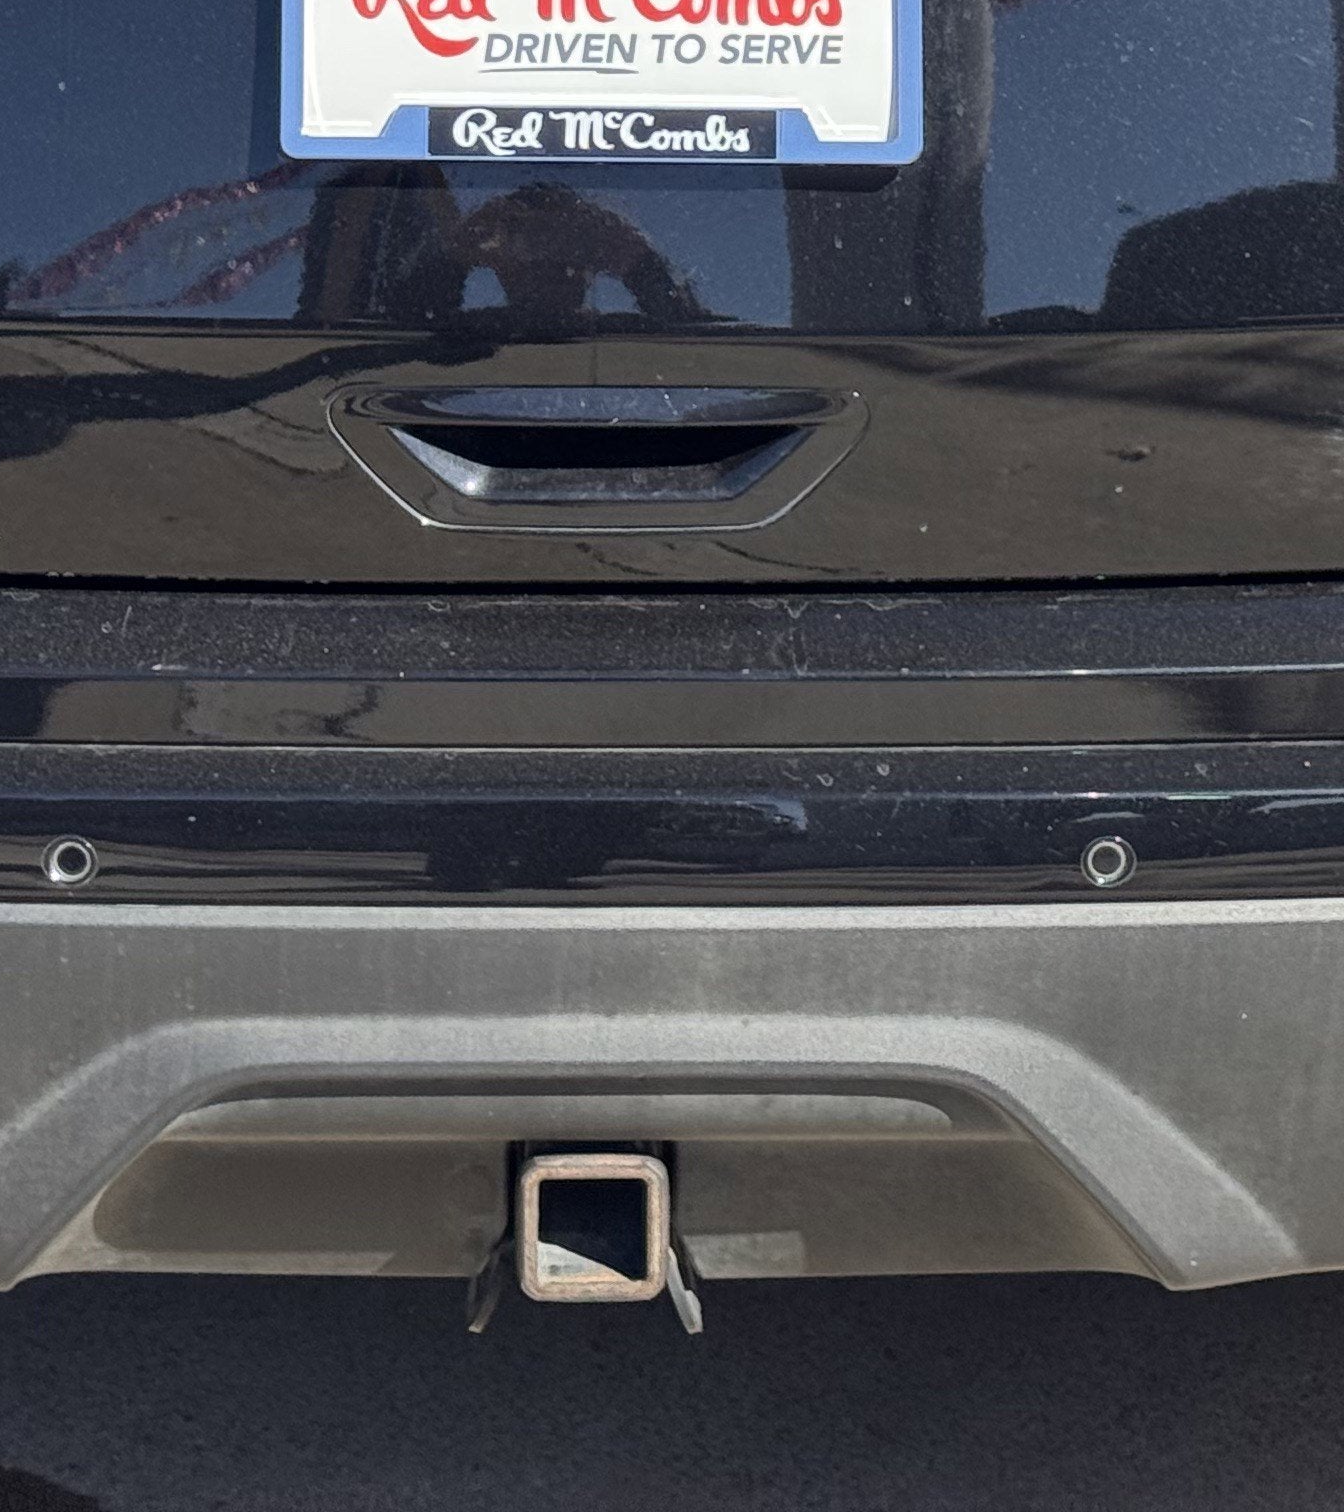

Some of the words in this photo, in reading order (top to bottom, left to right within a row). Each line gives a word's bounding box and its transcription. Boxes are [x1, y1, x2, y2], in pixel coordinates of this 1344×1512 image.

[483, 33, 638, 65] DRIVEN
[651, 33, 706, 65] TO
[718, 34, 844, 65] SERVE
[452, 107, 543, 155] Red
[549, 108, 750, 153] McCombs
